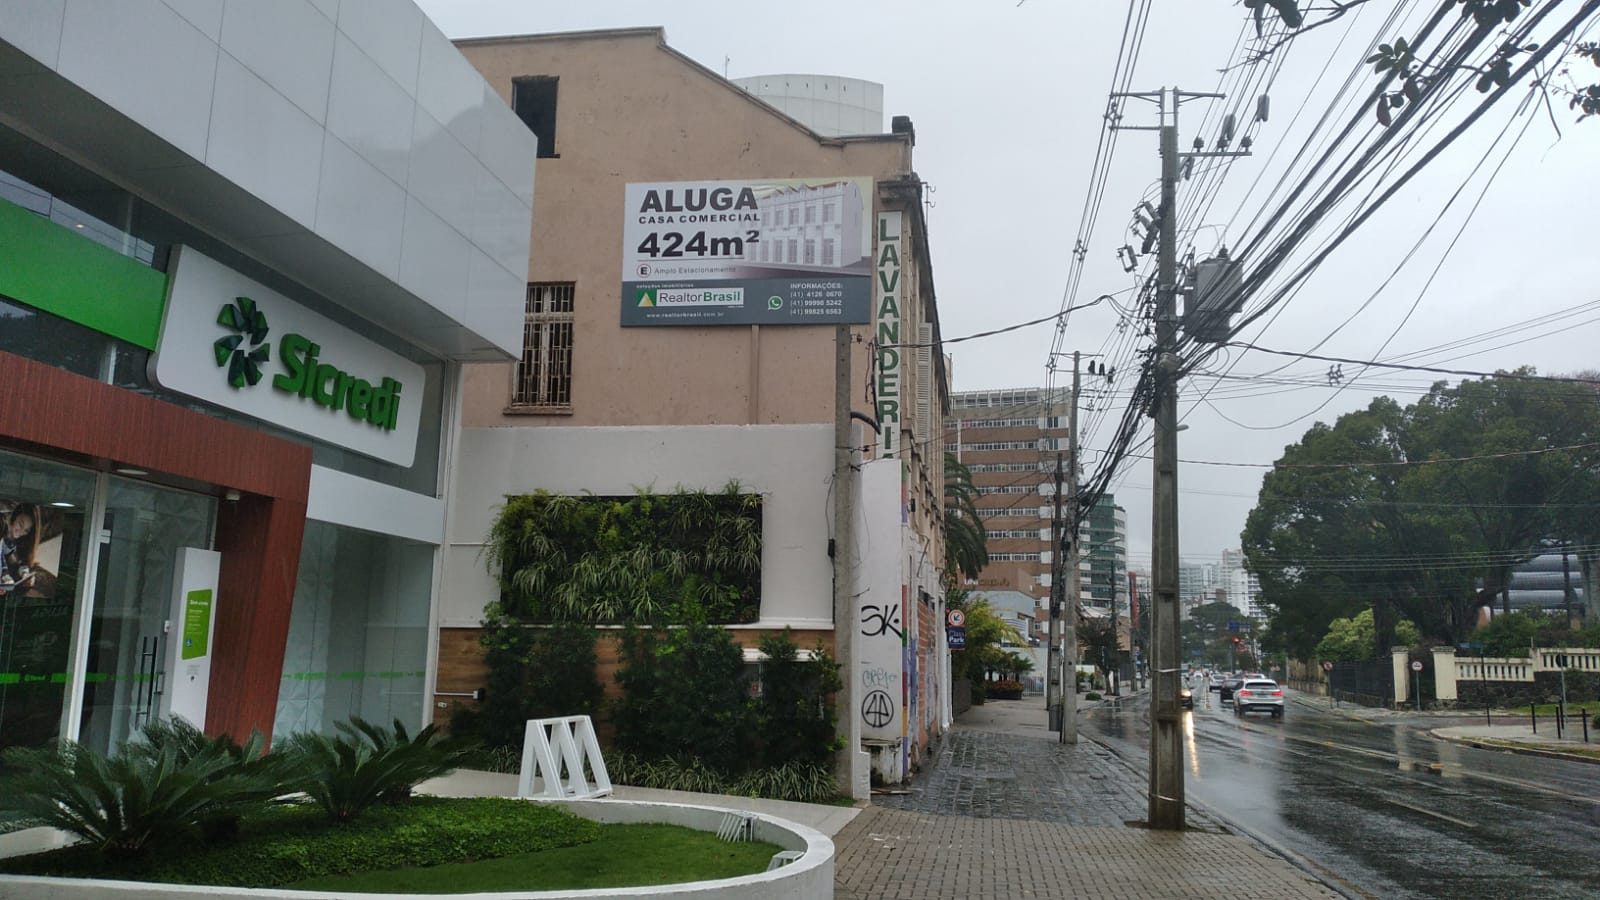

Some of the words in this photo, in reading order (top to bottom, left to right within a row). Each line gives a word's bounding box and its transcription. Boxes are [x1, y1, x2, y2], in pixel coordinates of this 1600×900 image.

[639, 216, 674, 224] CASA
[679, 214, 760, 223] COMERCIAL
[640, 187, 758, 213] ALUGA
[878, 218, 900, 459] LAVANDERI
[272, 333, 402, 431] Sicredi
